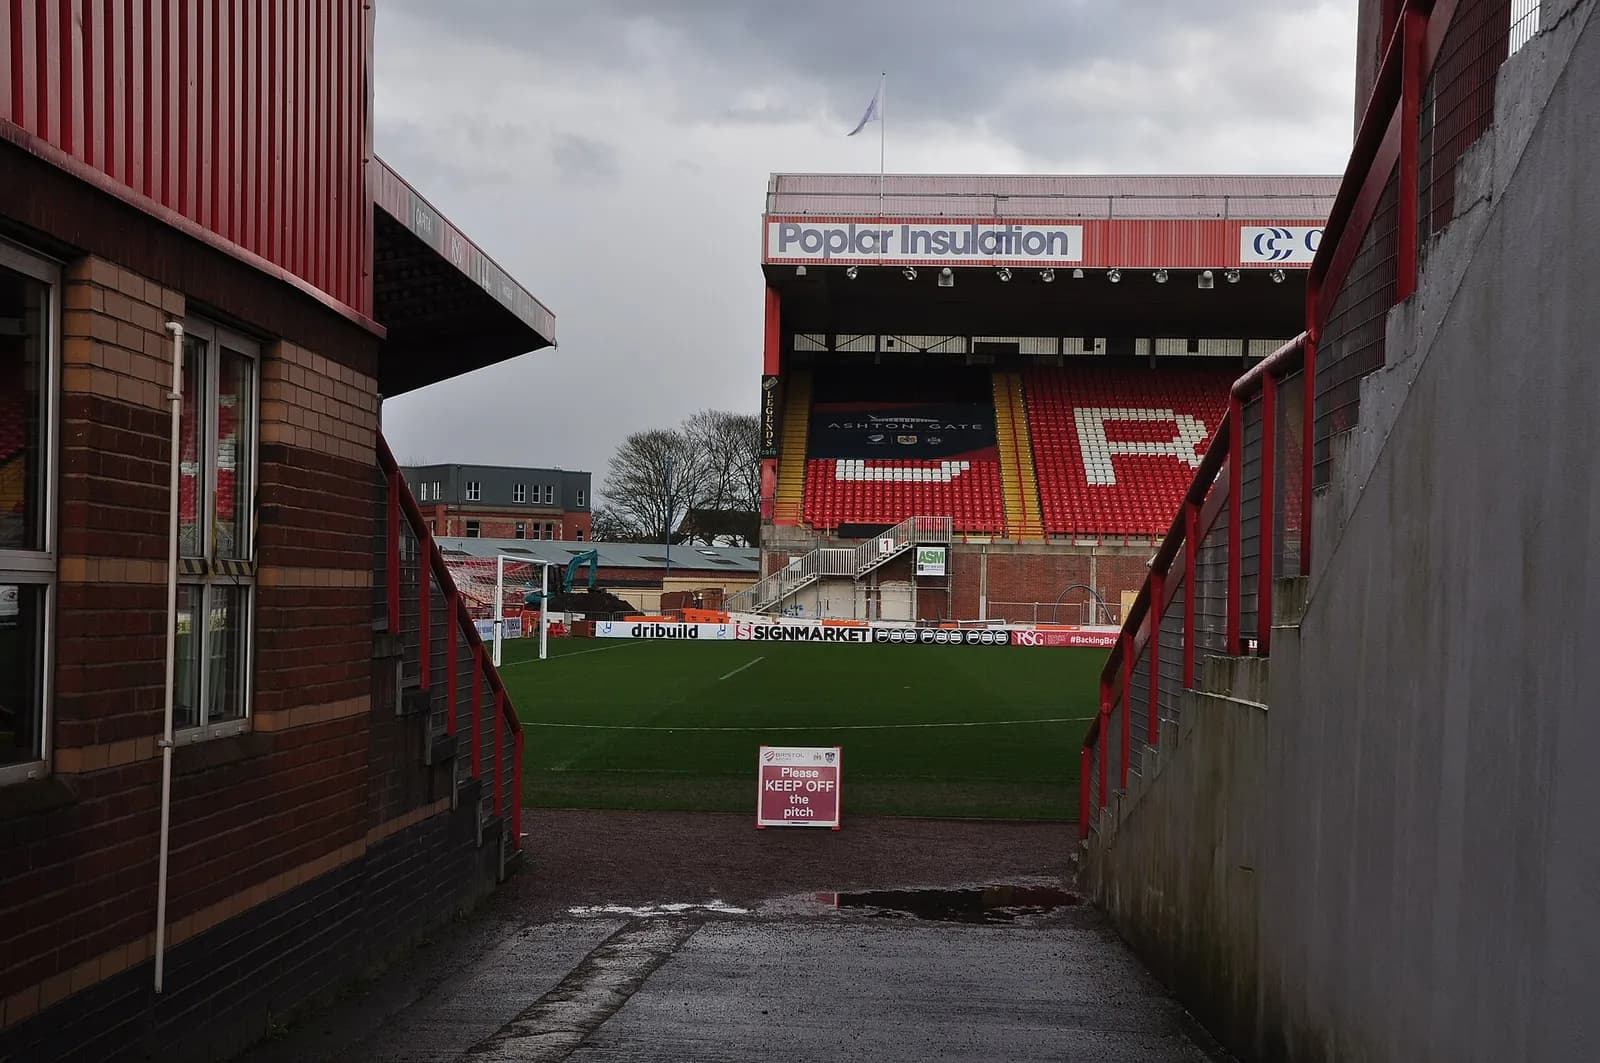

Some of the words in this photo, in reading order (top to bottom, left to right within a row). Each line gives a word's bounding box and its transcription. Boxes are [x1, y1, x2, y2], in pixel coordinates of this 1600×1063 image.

[778, 223, 893, 258] Poplar
[900, 223, 1068, 257] Insulation
[764, 391, 775, 447] LEGENDS
[827, 422, 914, 430] ASHTON
[928, 423, 984, 431] GATE
[883, 540, 889, 552] 1
[918, 551, 944, 564] ASM
[631, 623, 698, 639] dribuild
[753, 626, 870, 642] SIGNMARKET
[1017, 631, 1043, 646] RSG
[1070, 635, 1117, 646] #BackingBri
[781, 767, 819, 778] Please
[765, 780, 802, 792] KEEP
[806, 780, 834, 792] OFF
[789, 794, 809, 804] the
[784, 807, 813, 819] pitch
